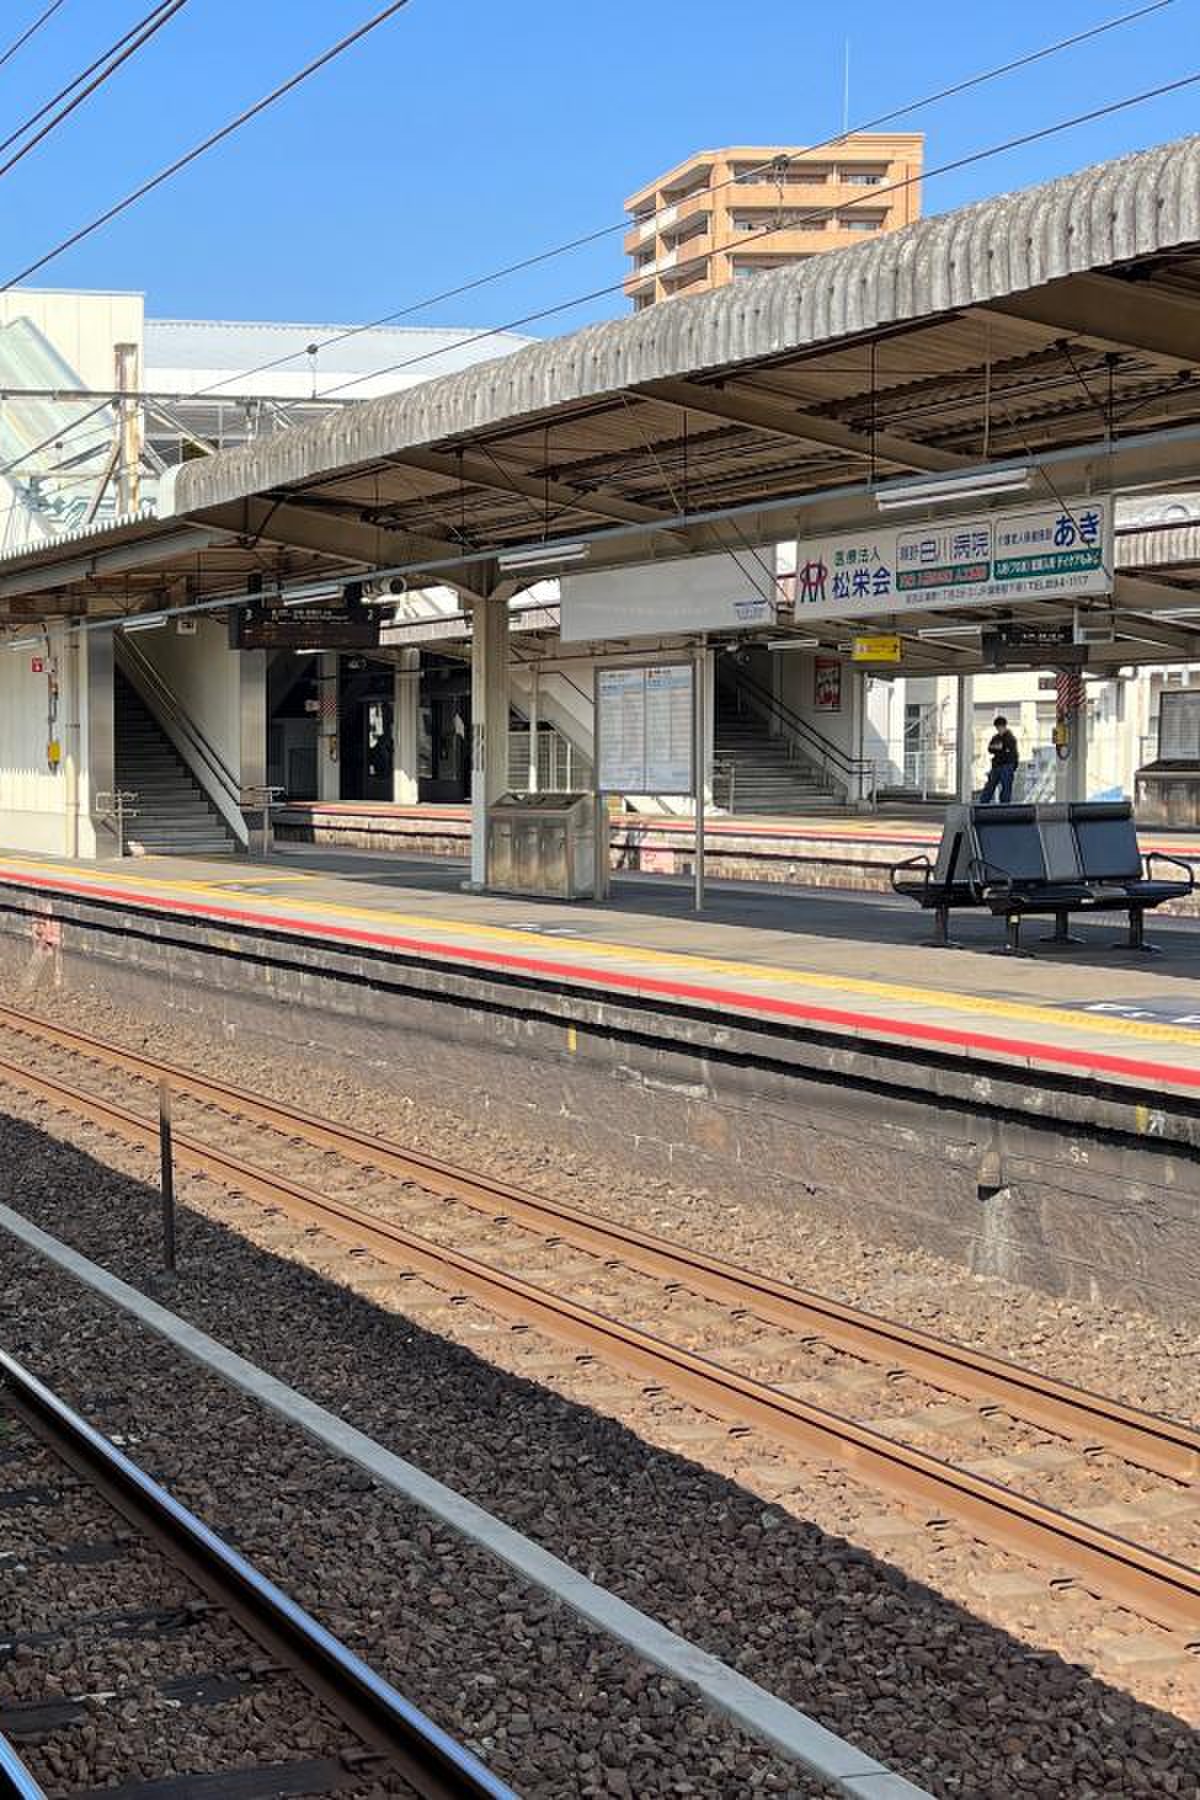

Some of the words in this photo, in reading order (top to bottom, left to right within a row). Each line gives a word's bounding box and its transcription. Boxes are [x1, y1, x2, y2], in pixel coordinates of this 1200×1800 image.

[1054, 511, 1101, 547] あき
[832, 566, 891, 599] 松栄会
